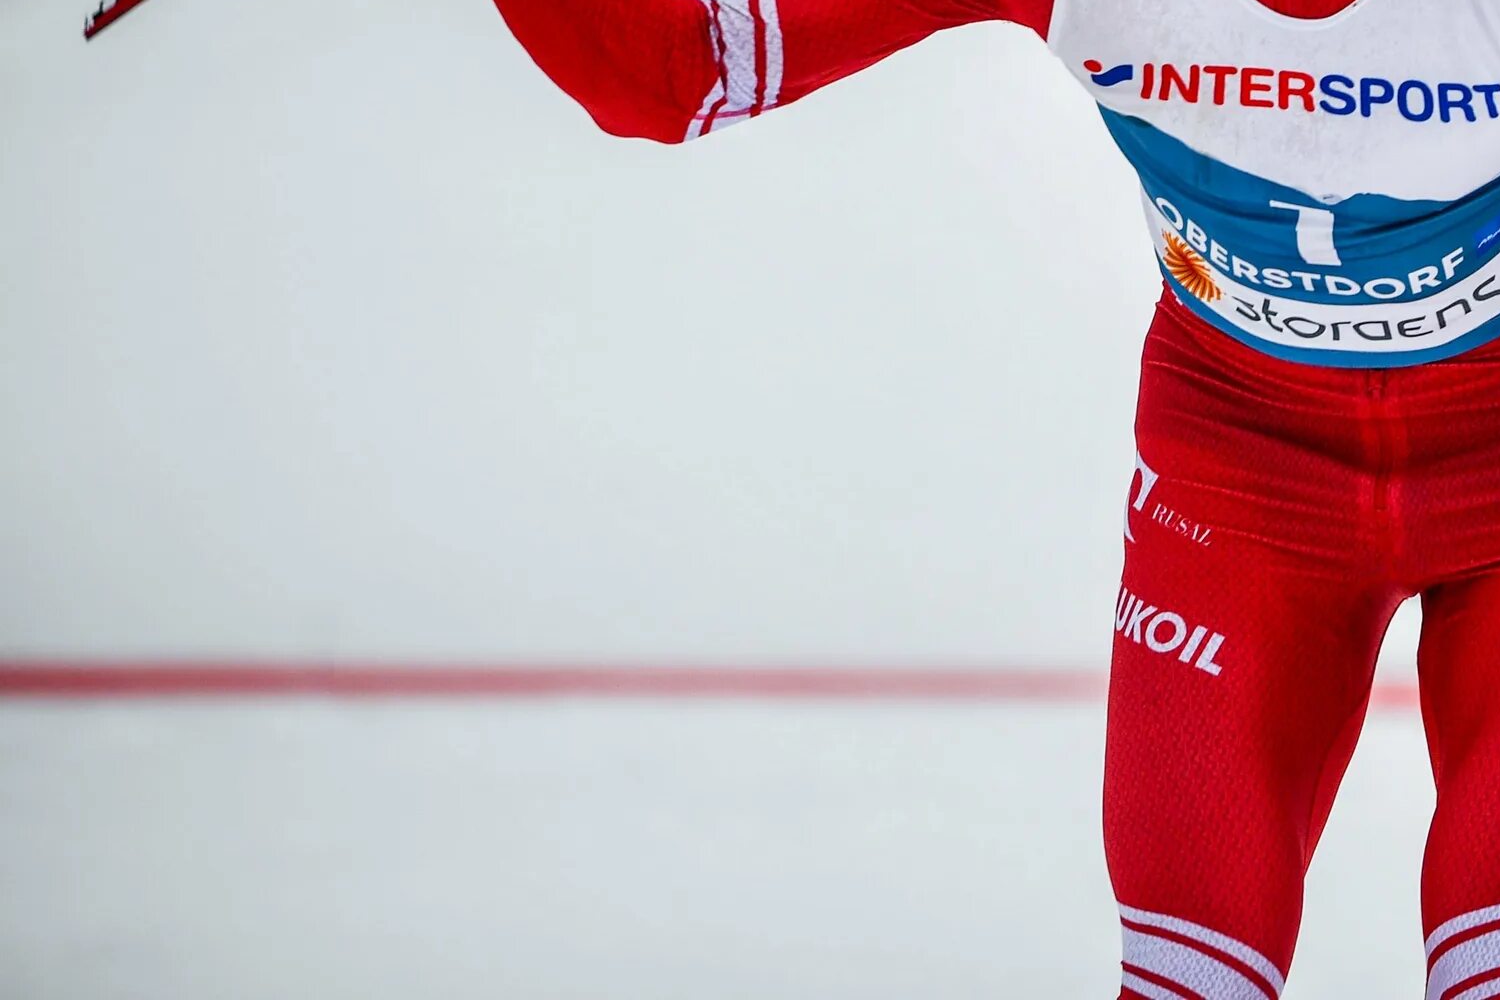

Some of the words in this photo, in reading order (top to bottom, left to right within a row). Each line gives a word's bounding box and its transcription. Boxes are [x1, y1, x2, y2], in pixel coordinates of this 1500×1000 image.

[1155, 197, 1465, 300] OBERSTDORF
[1152, 503, 1213, 547] RUSAL
[1115, 582, 1226, 677] UKOIL
